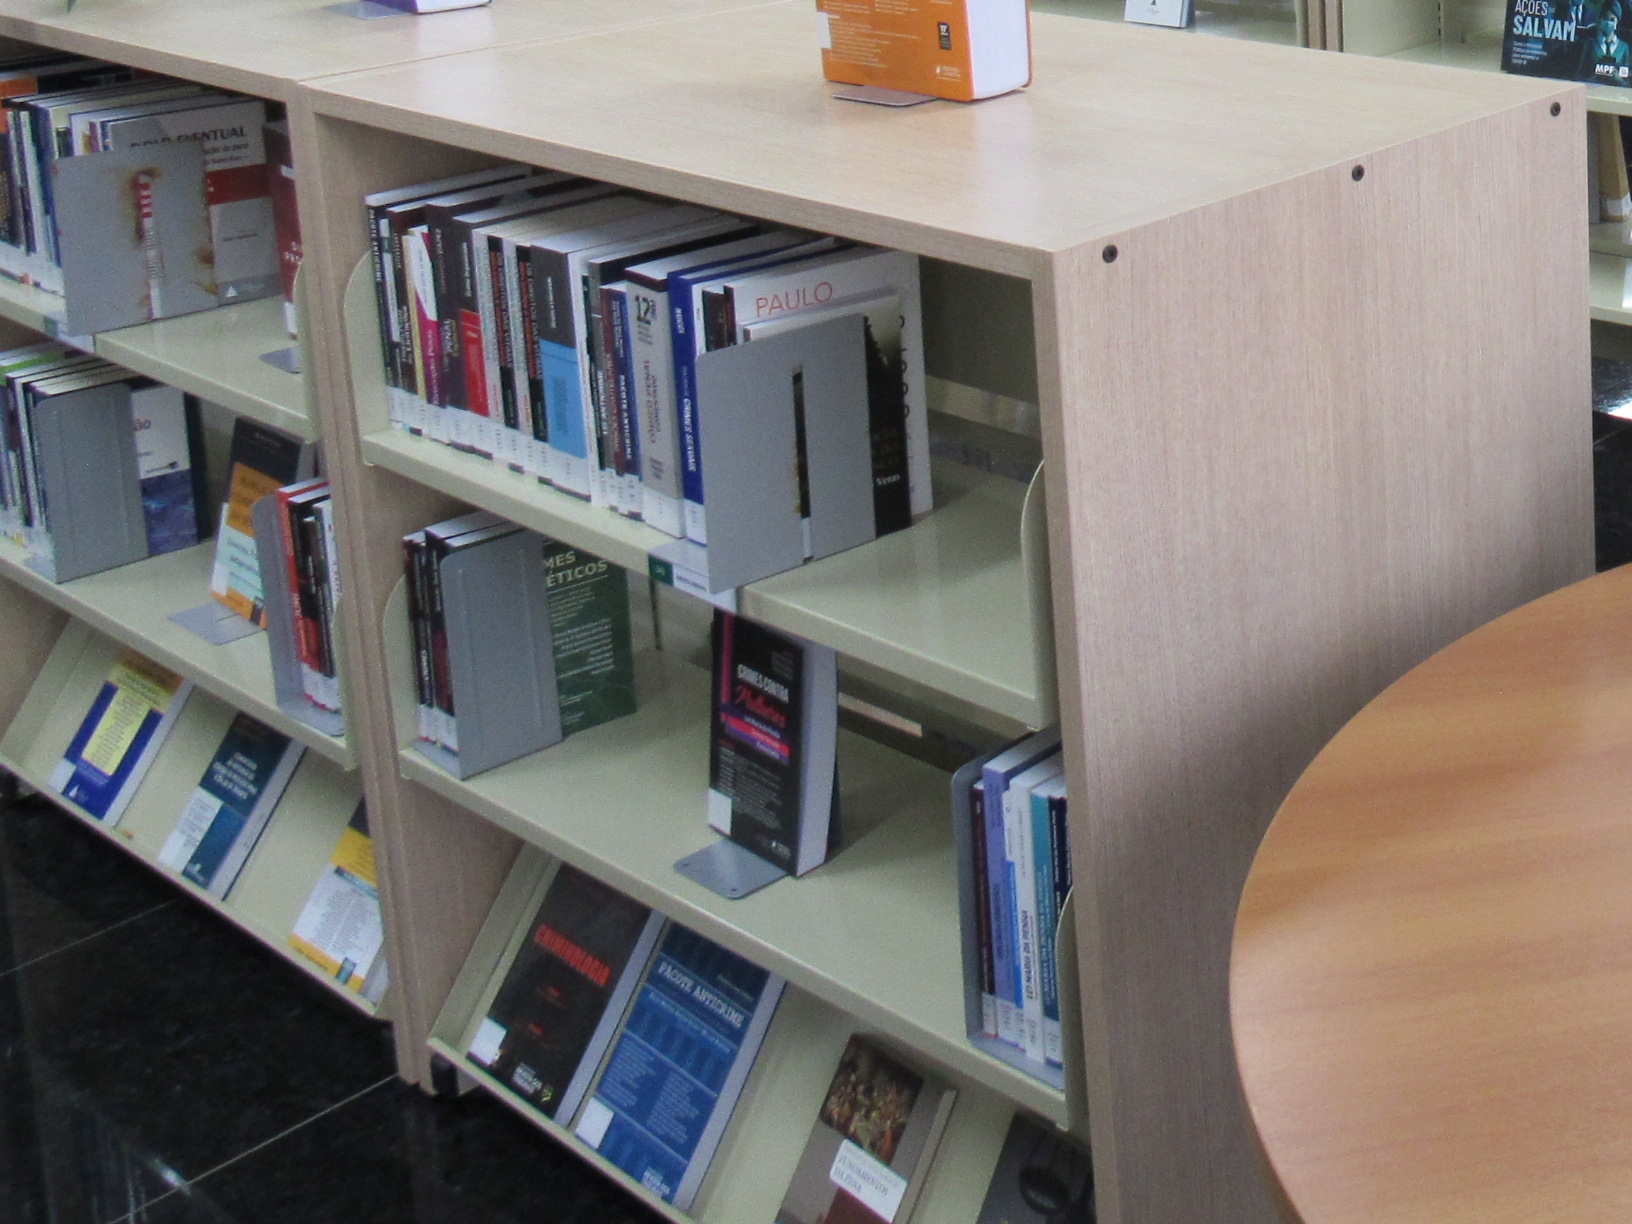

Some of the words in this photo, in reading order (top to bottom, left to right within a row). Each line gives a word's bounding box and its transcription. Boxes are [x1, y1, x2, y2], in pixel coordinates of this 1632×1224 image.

[1512, 14, 1576, 43] SALVAM
[1595, 63, 1615, 75] MPF
[435, 227, 443, 254] CAPEZ
[755, 282, 833, 318] PAULO
[443, 318, 453, 353] PENAL
[675, 307, 685, 335] NUCCI
[619, 375, 628, 410] PACOTE
[682, 397, 694, 433] CRIMES
[622, 412, 632, 460] ANTICRIME
[685, 433, 696, 472] SEXUAIS
[875, 473, 902, 487] Veras
[1020, 909, 1031, 941] PENHA
[1023, 941, 1032, 956] DA
[1023, 956, 1033, 983] MARIA
[658, 961, 701, 994] PACOTE
[698, 984, 747, 1030] ANTICRIME
[1024, 984, 1034, 1000] LEI
